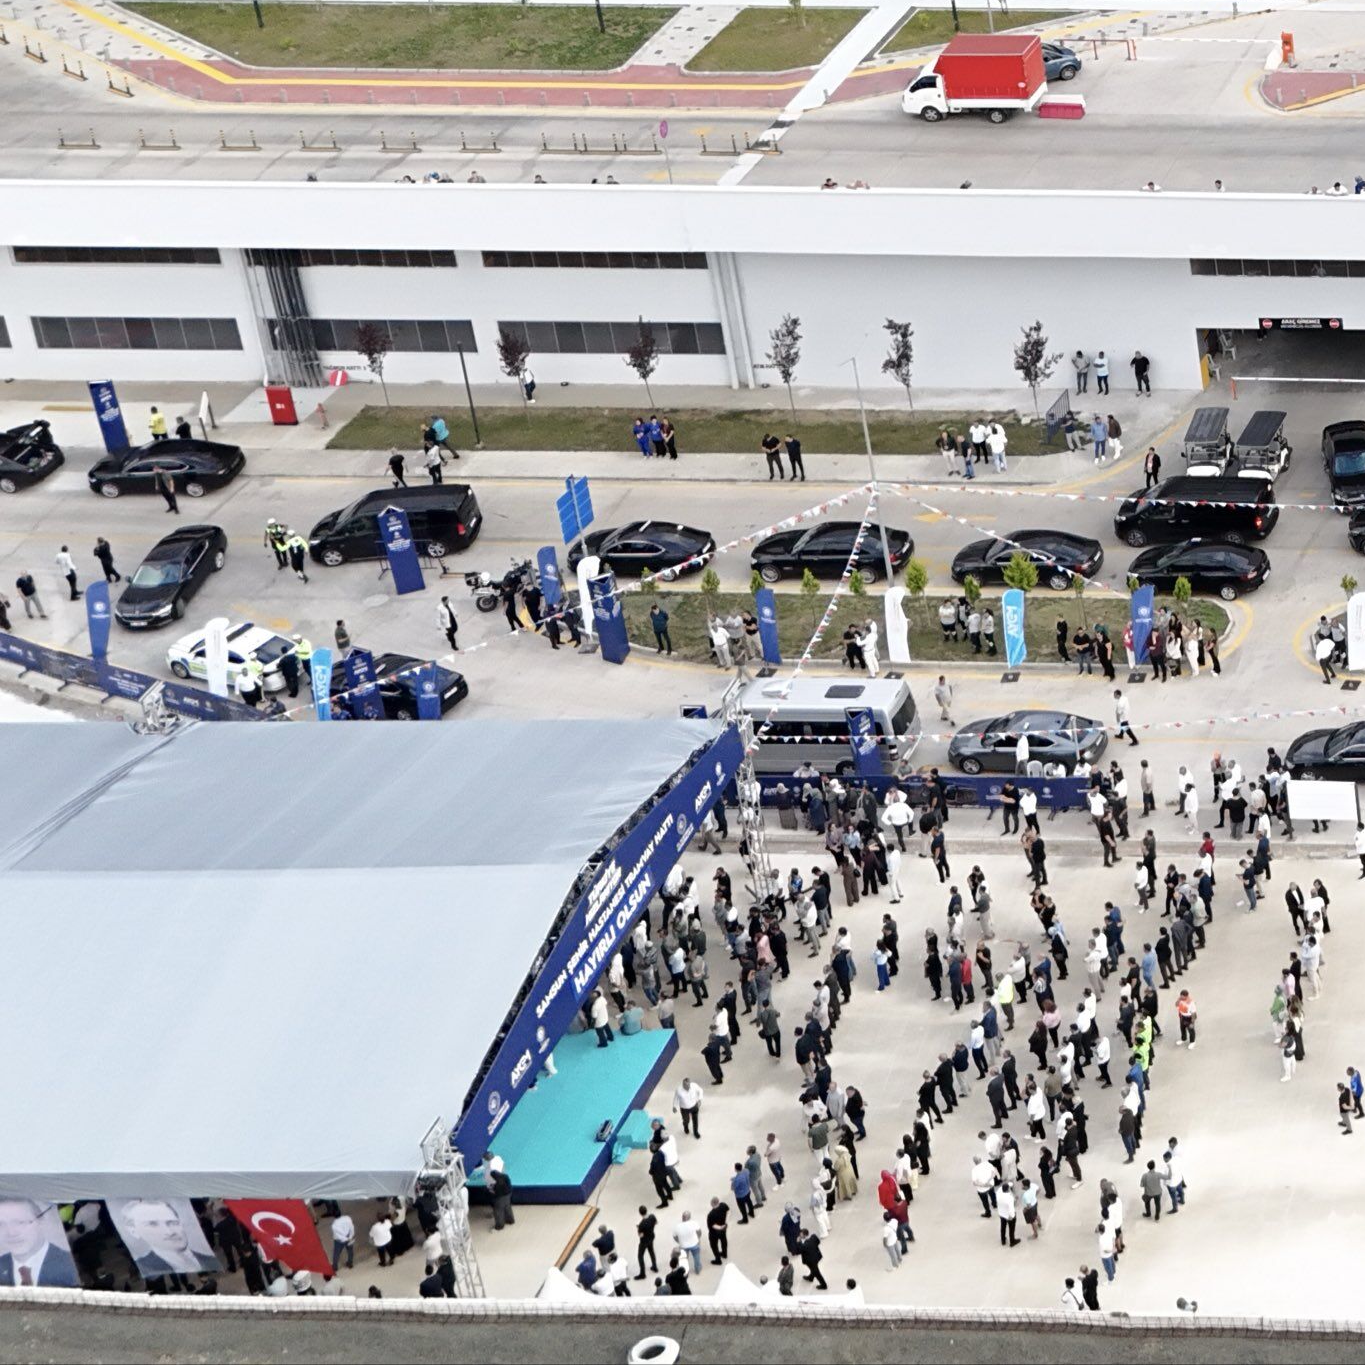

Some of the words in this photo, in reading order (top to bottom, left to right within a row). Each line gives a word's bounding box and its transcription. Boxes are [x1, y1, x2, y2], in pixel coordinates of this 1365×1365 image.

[536, 970, 567, 1019] SAMSUN
[566, 938, 590, 977] ŞEHİR
[588, 884, 626, 942] HASTANESİ
[624, 843, 656, 888] TRAMVAY
[654, 813, 674, 848] HATTI
[573, 924, 617, 995] HAYIRLI
[616, 873, 651, 931] OLSUN
